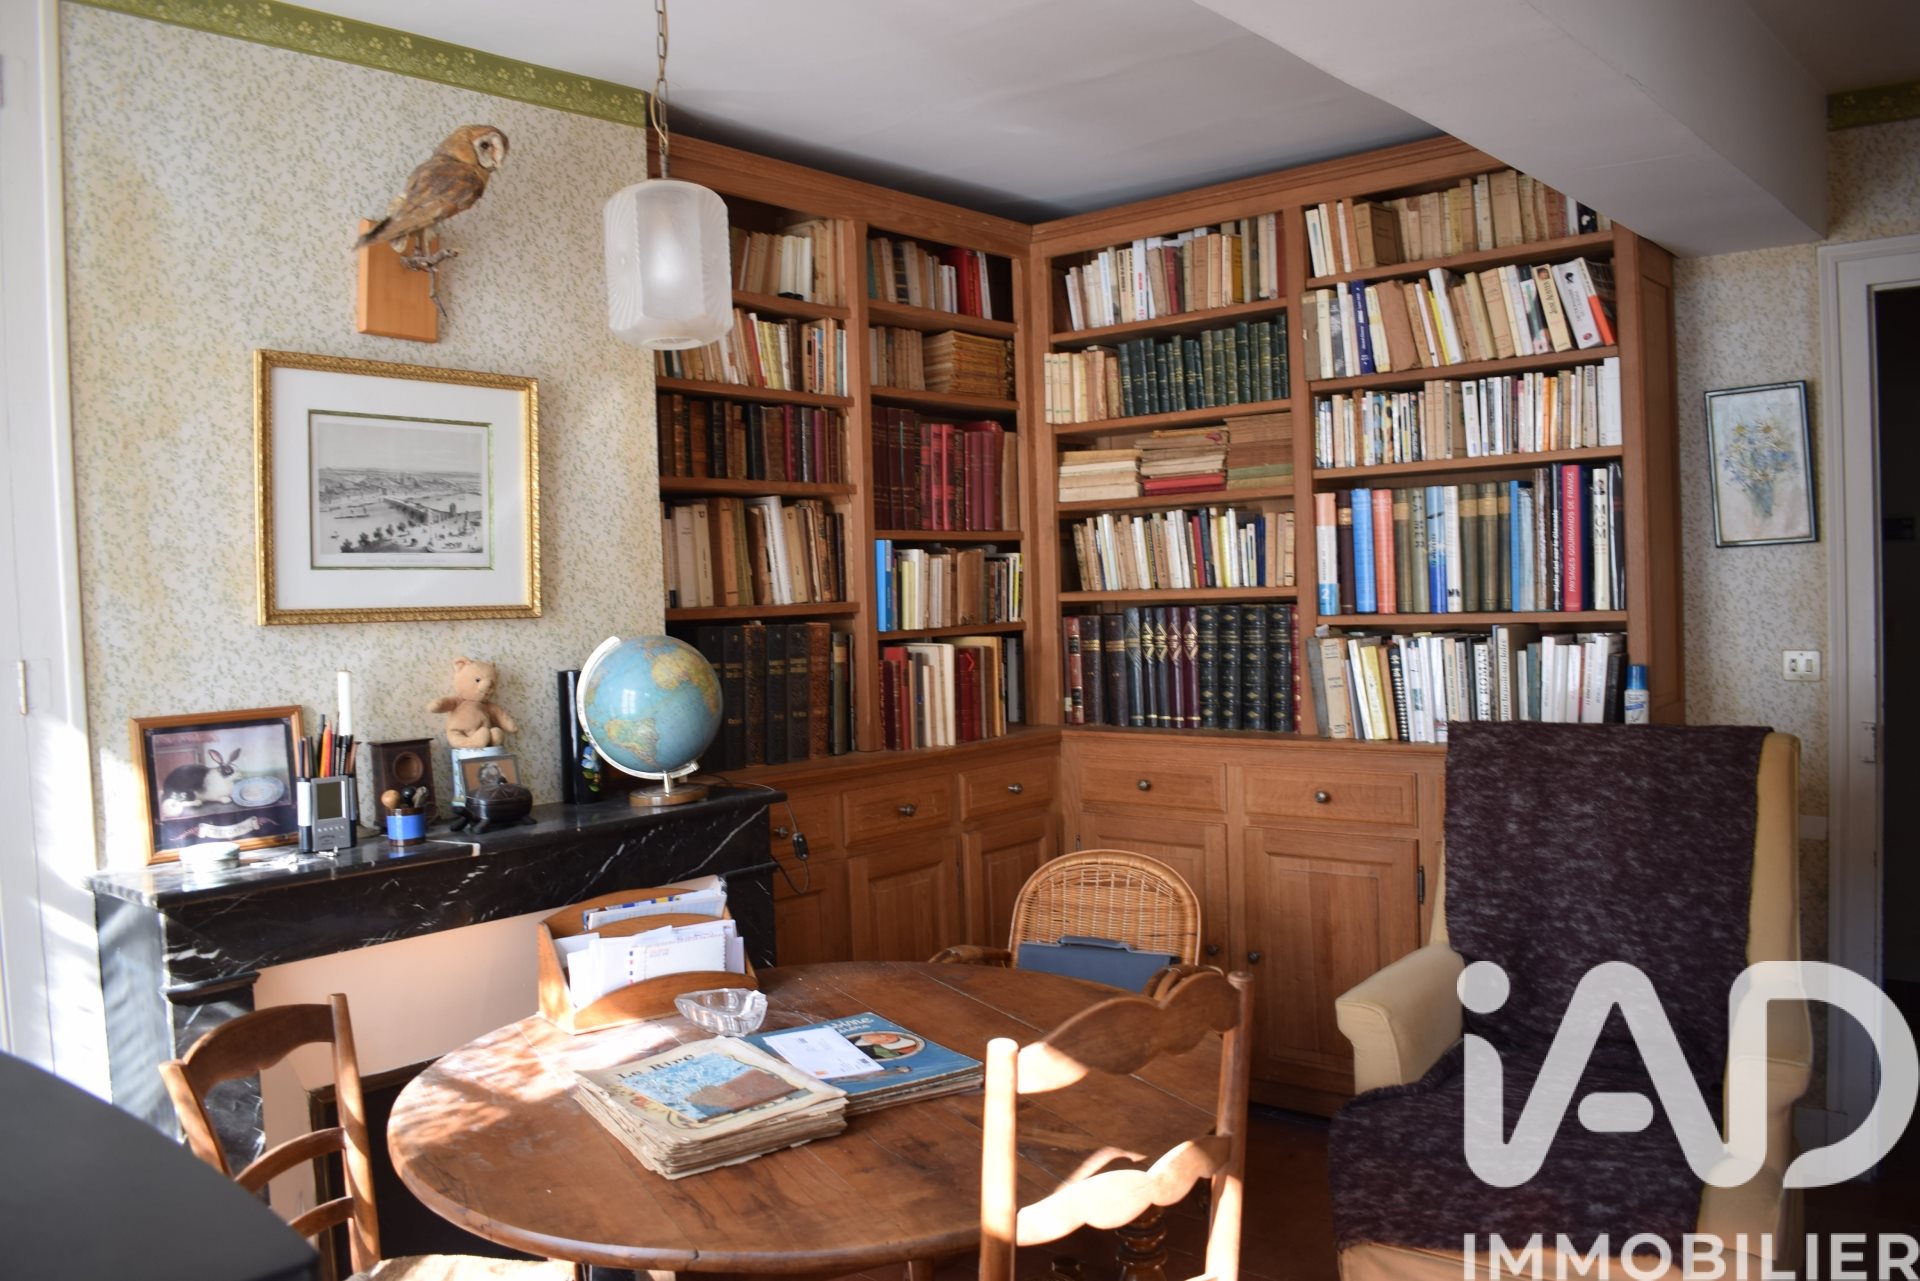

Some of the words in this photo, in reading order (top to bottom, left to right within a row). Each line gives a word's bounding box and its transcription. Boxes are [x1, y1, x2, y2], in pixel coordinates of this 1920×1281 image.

[1566, 471, 1574, 498] FRANCE
[1567, 500, 1574, 510] DE
[1567, 511, 1576, 556] GOURMANDS
[1568, 557, 1576, 592] PAYSAGES
[1478, 648, 1488, 694] ROMAN
[616, 1069, 644, 1079] Le
